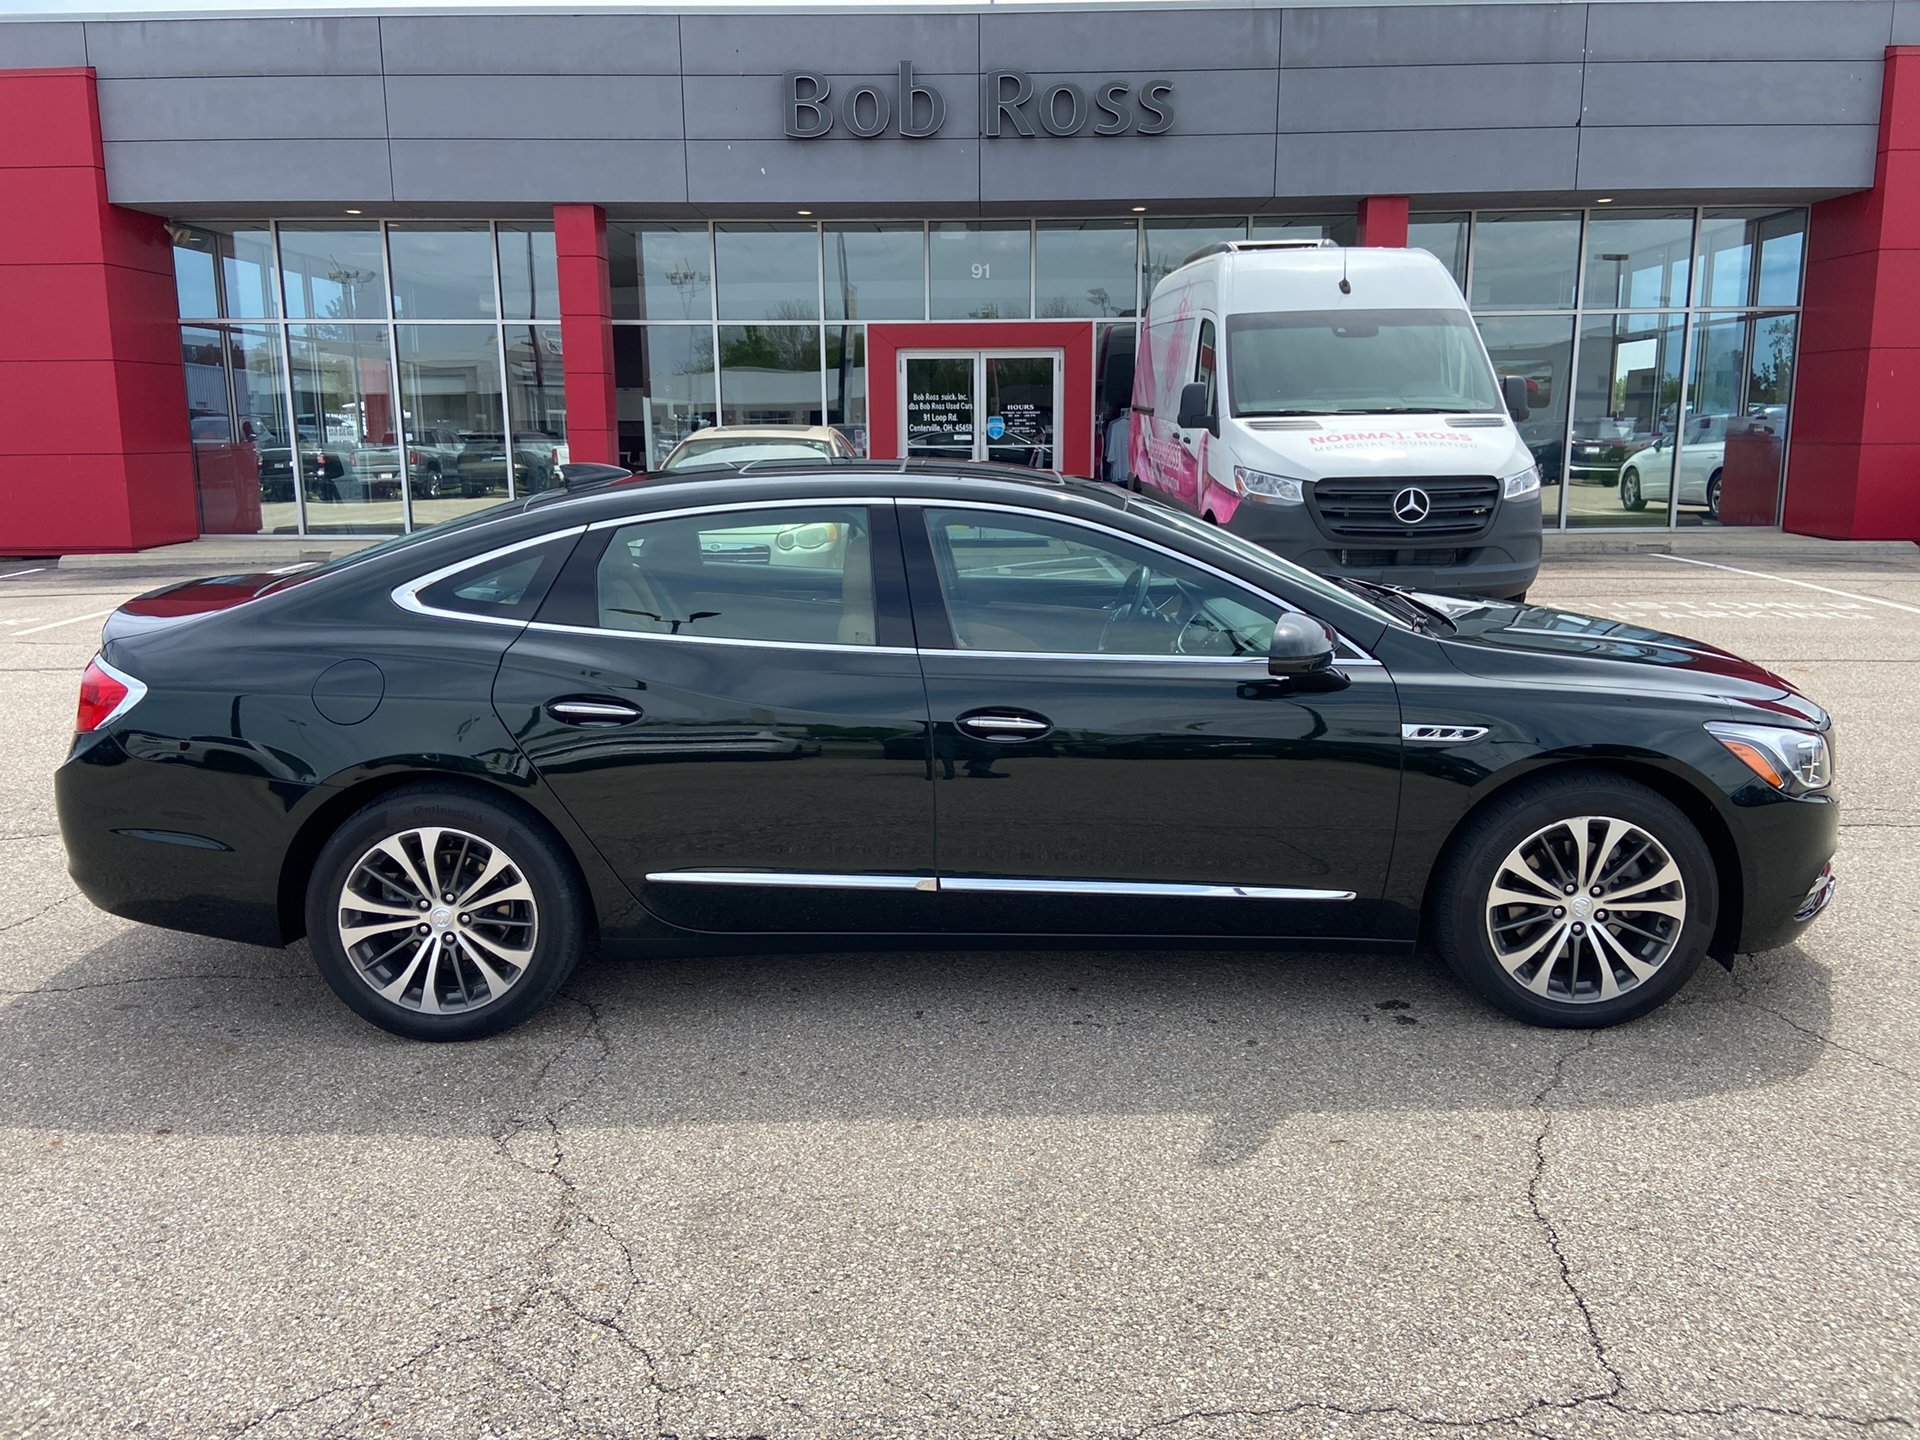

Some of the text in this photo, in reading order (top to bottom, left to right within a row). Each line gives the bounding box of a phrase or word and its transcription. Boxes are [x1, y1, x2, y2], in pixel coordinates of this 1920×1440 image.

[782, 60, 1176, 138] Bob Ross
[971, 263, 990, 279] 91
[913, 392, 925, 401] Bob
[925, 393, 939, 401] Ross
[958, 392, 968, 401] Inc.
[908, 402, 973, 411] dba Bob Ross Used Cars
[923, 413, 958, 423] 91 Loop Rd.
[1309, 432, 1394, 445] NORMA
[1414, 432, 1473, 442] ROSS
[1314, 440, 1480, 452] MEMORIAL FOUNDATION
